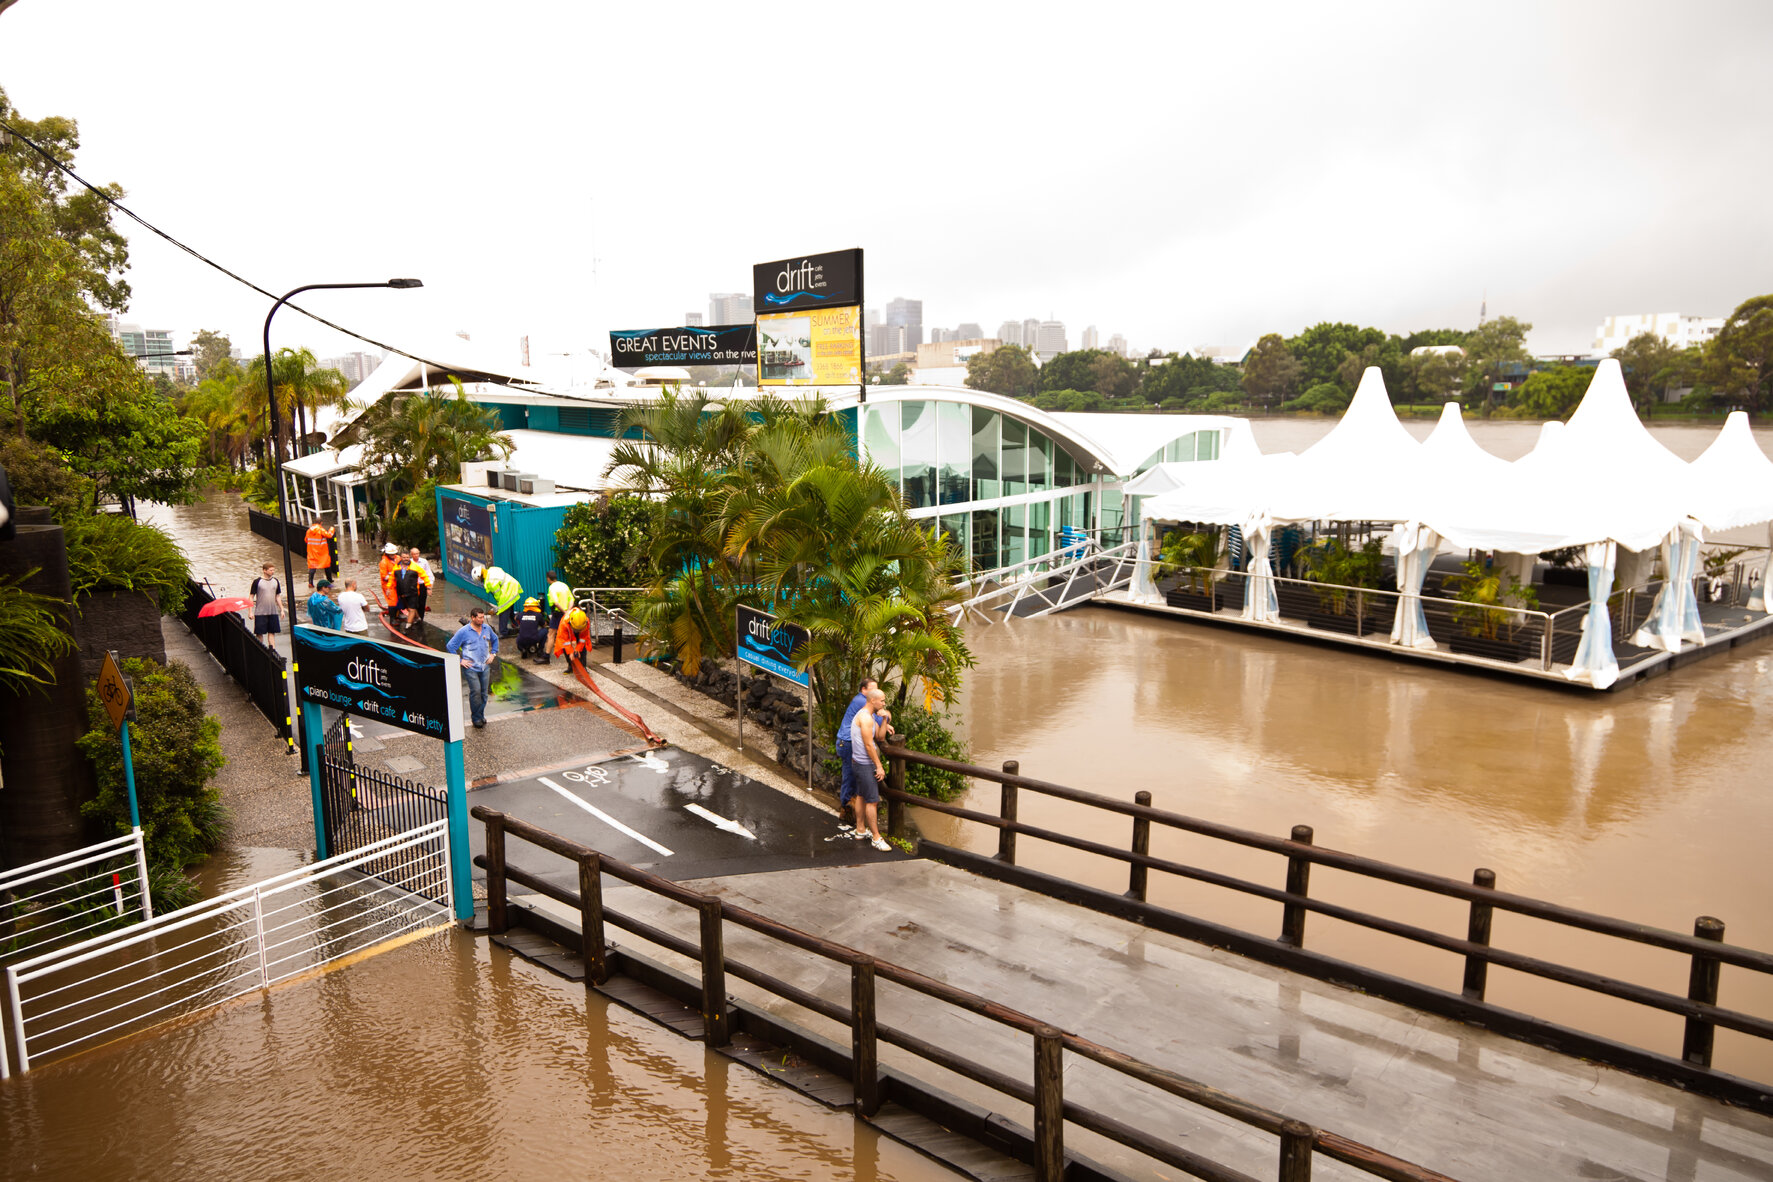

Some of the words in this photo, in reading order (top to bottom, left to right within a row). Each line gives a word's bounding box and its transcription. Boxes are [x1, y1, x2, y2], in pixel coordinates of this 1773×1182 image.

[777, 259, 815, 292] drift
[812, 312, 850, 327] SUMMER
[616, 336, 658, 352] GREAT
[662, 334, 718, 351] EVENTS
[644, 350, 687, 362] spectacular
[689, 350, 712, 360] views
[713, 351, 724, 359] on
[726, 349, 739, 359] the
[749, 616, 770, 640] drift
[770, 627, 794, 653] jetty
[347, 656, 381, 686] drift
[309, 685, 329, 699] piano
[329, 689, 352, 706] lounge
[363, 700, 380, 713] drift
[380, 705, 396, 718] cafe
[408, 712, 425, 726] drift
[425, 716, 444, 733] jetty
